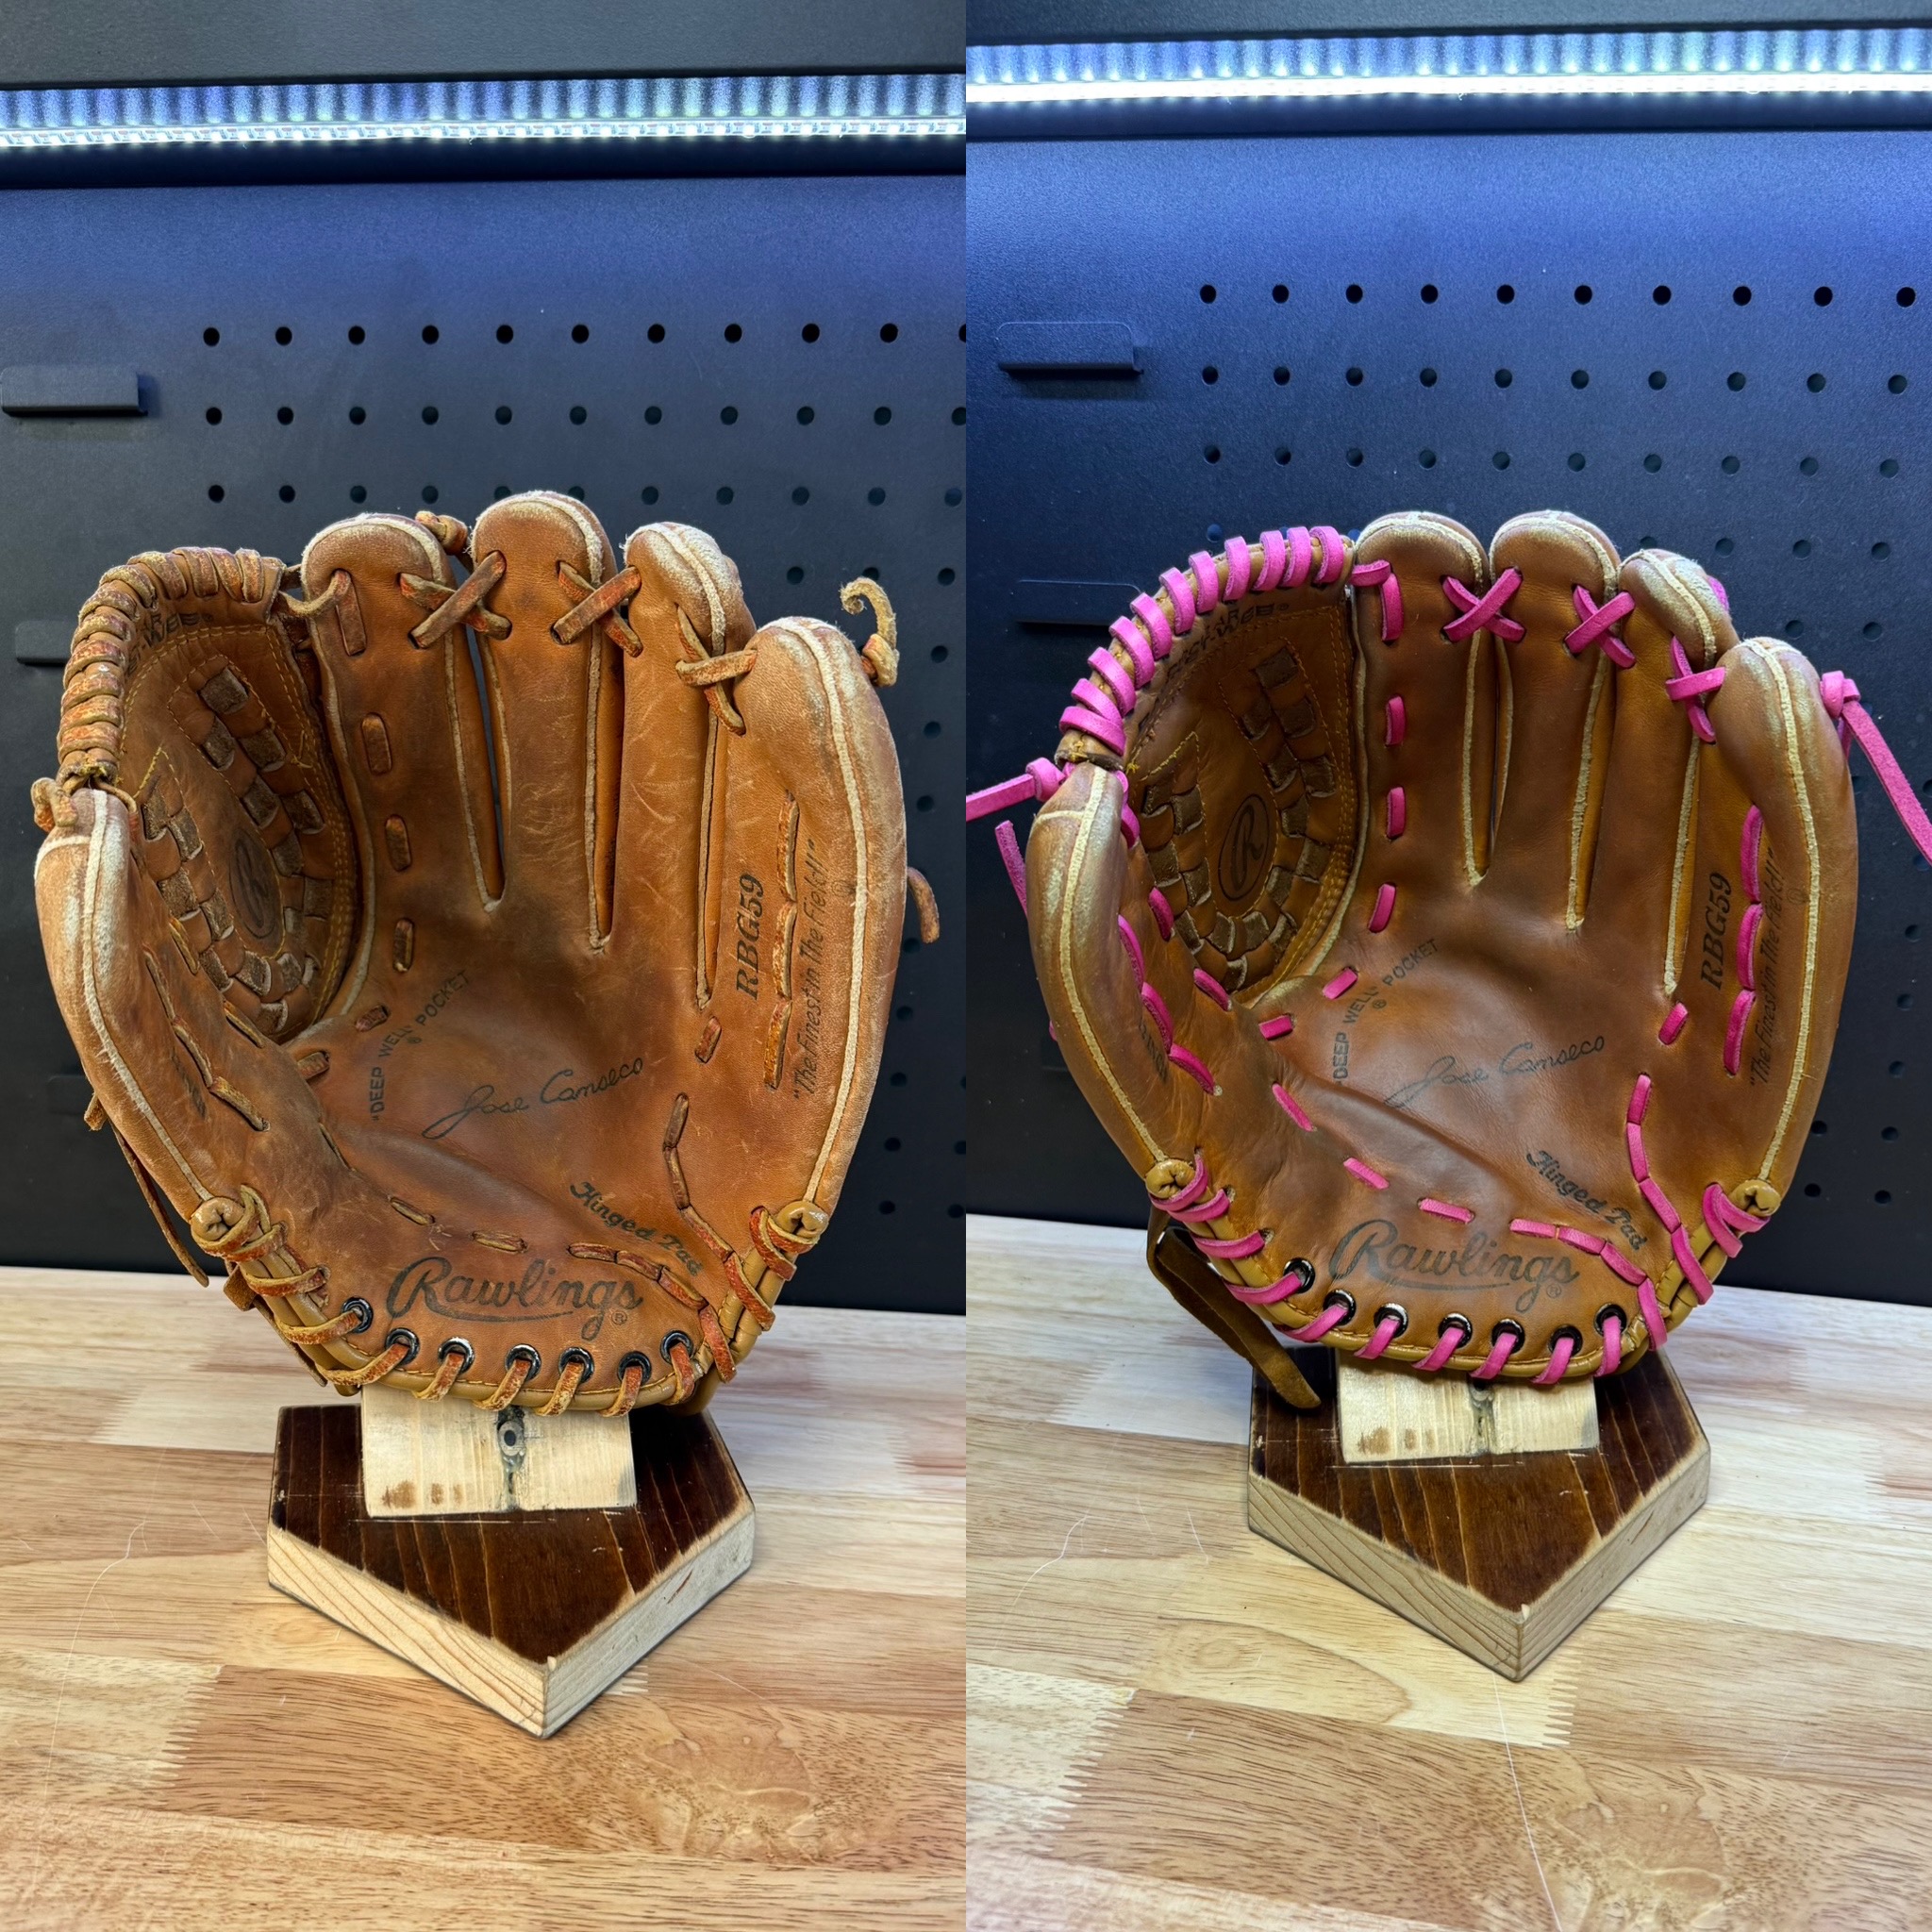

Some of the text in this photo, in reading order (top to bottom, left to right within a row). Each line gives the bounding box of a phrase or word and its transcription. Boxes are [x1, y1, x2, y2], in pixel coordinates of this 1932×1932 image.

[737, 874, 764, 1000] RBG59
[799, 928, 824, 965] The
[1383, 938, 1439, 987] POCKET
[1701, 872, 1732, 991] RBG59
[1760, 929, 1779, 964] The
[416, 969, 471, 1026] POCKET
[801, 967, 824, 990] in
[1760, 966, 1777, 987] in
[797, 987, 822, 1057] Finest
[1755, 984, 1776, 1049] Finest
[422, 1058, 643, 1140] Jose Canseco
[1384, 1037, 1605, 1109] Jose Canseco
[570, 1182, 704, 1276] Hinged Pad
[1526, 1150, 1647, 1251] Hinged Pad
